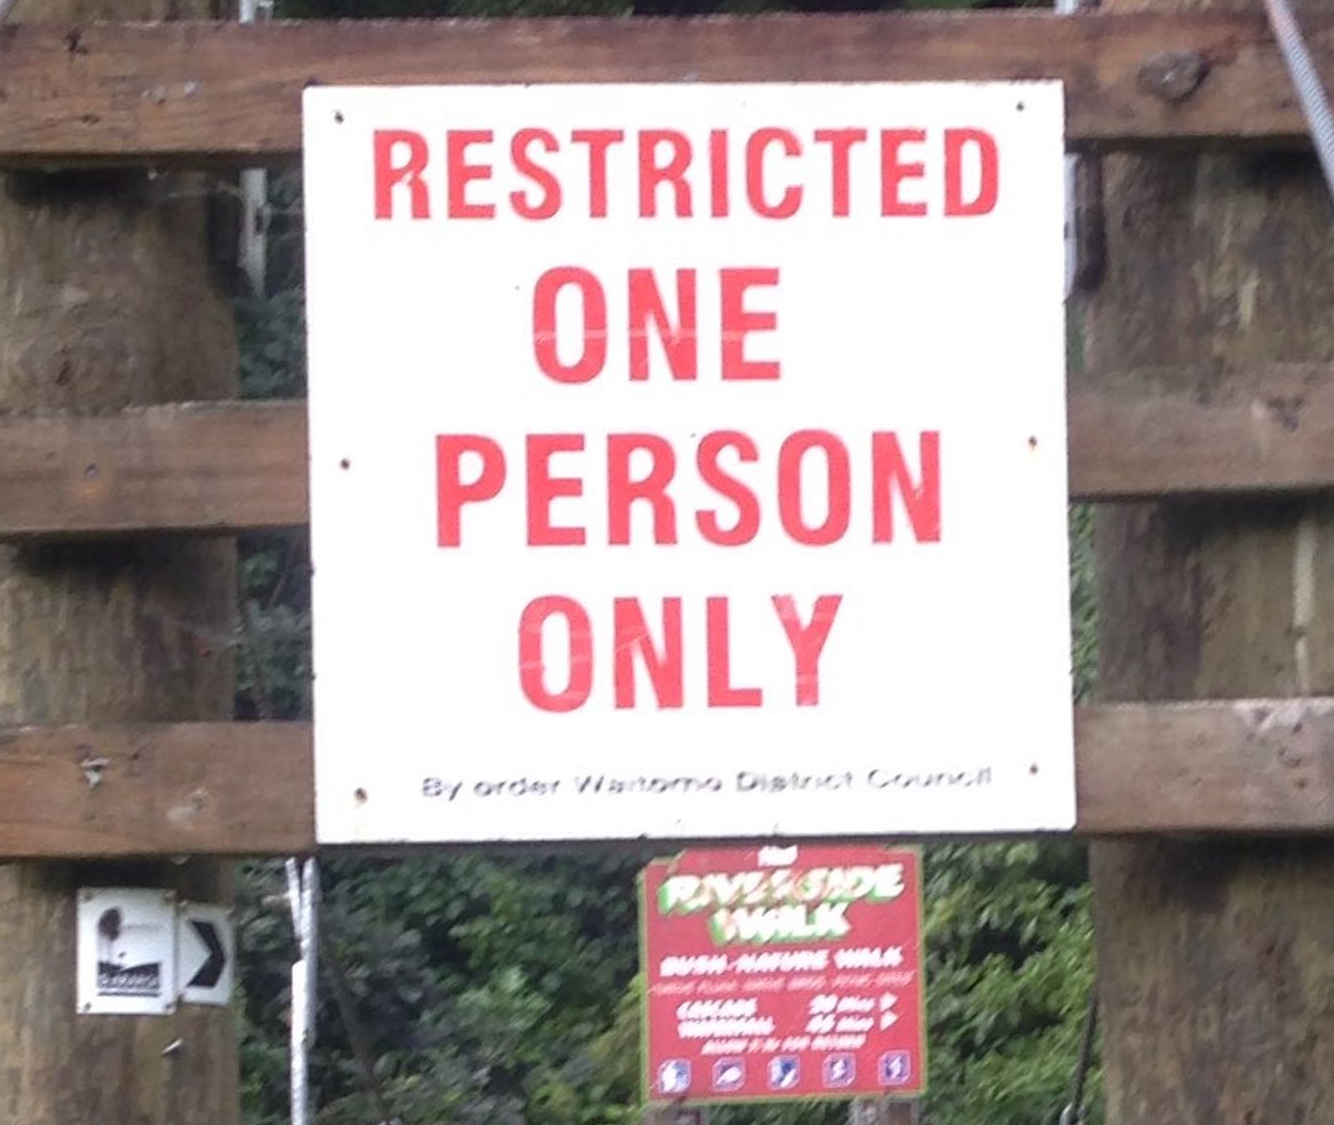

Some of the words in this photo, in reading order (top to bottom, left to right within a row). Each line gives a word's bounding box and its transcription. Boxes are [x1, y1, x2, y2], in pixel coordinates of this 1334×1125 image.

[372, 126, 1000, 220] RESTRICTED
[531, 266, 781, 384] ONE
[435, 429, 942, 548] PERSON
[518, 594, 843, 712] ONLY
[421, 775, 464, 801] By
[473, 774, 562, 797] order
[574, 772, 724, 795] Waitomo
[735, 768, 856, 792] District
[867, 764, 994, 789] Council
[709, 903, 851, 943] WALK
